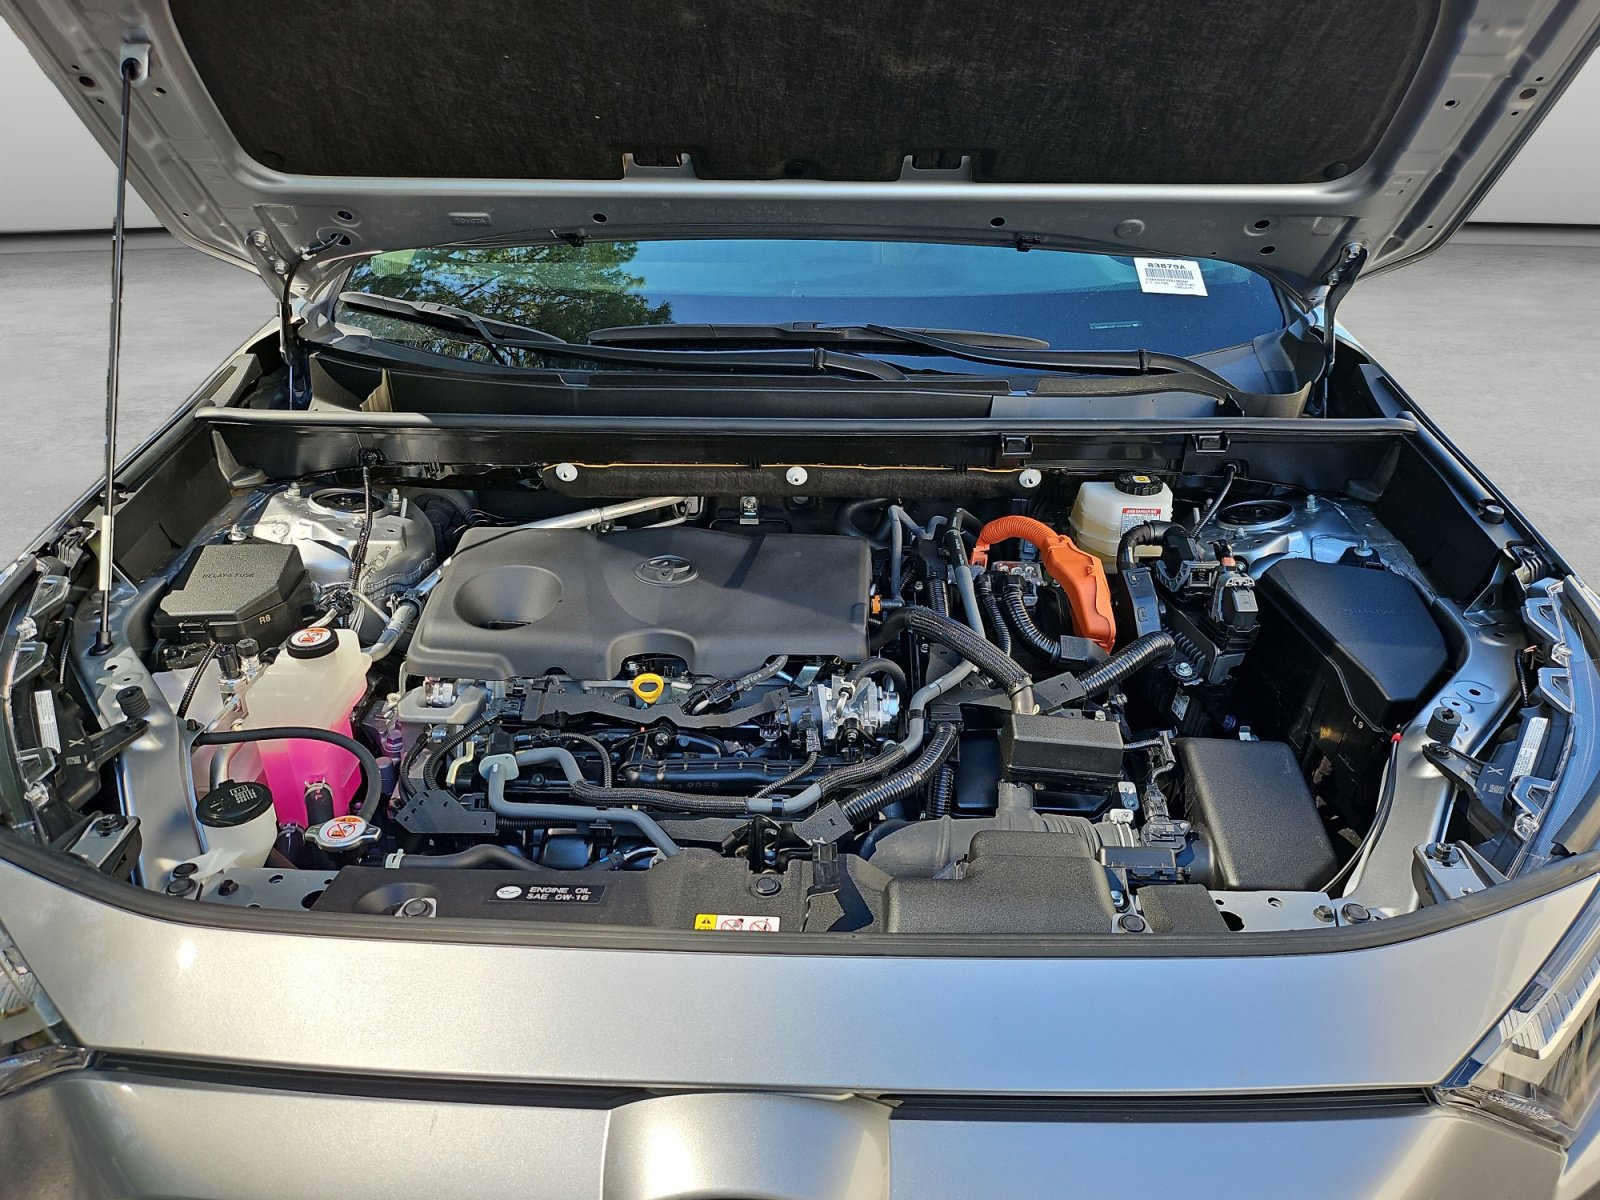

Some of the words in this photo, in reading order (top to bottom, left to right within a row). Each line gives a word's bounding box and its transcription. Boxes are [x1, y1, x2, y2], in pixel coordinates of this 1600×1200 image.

[258, 614, 272, 625] R8
[1352, 714, 1364, 729] L9
[529, 886, 570, 894] ENGINE
[574, 887, 592, 895] OIL
